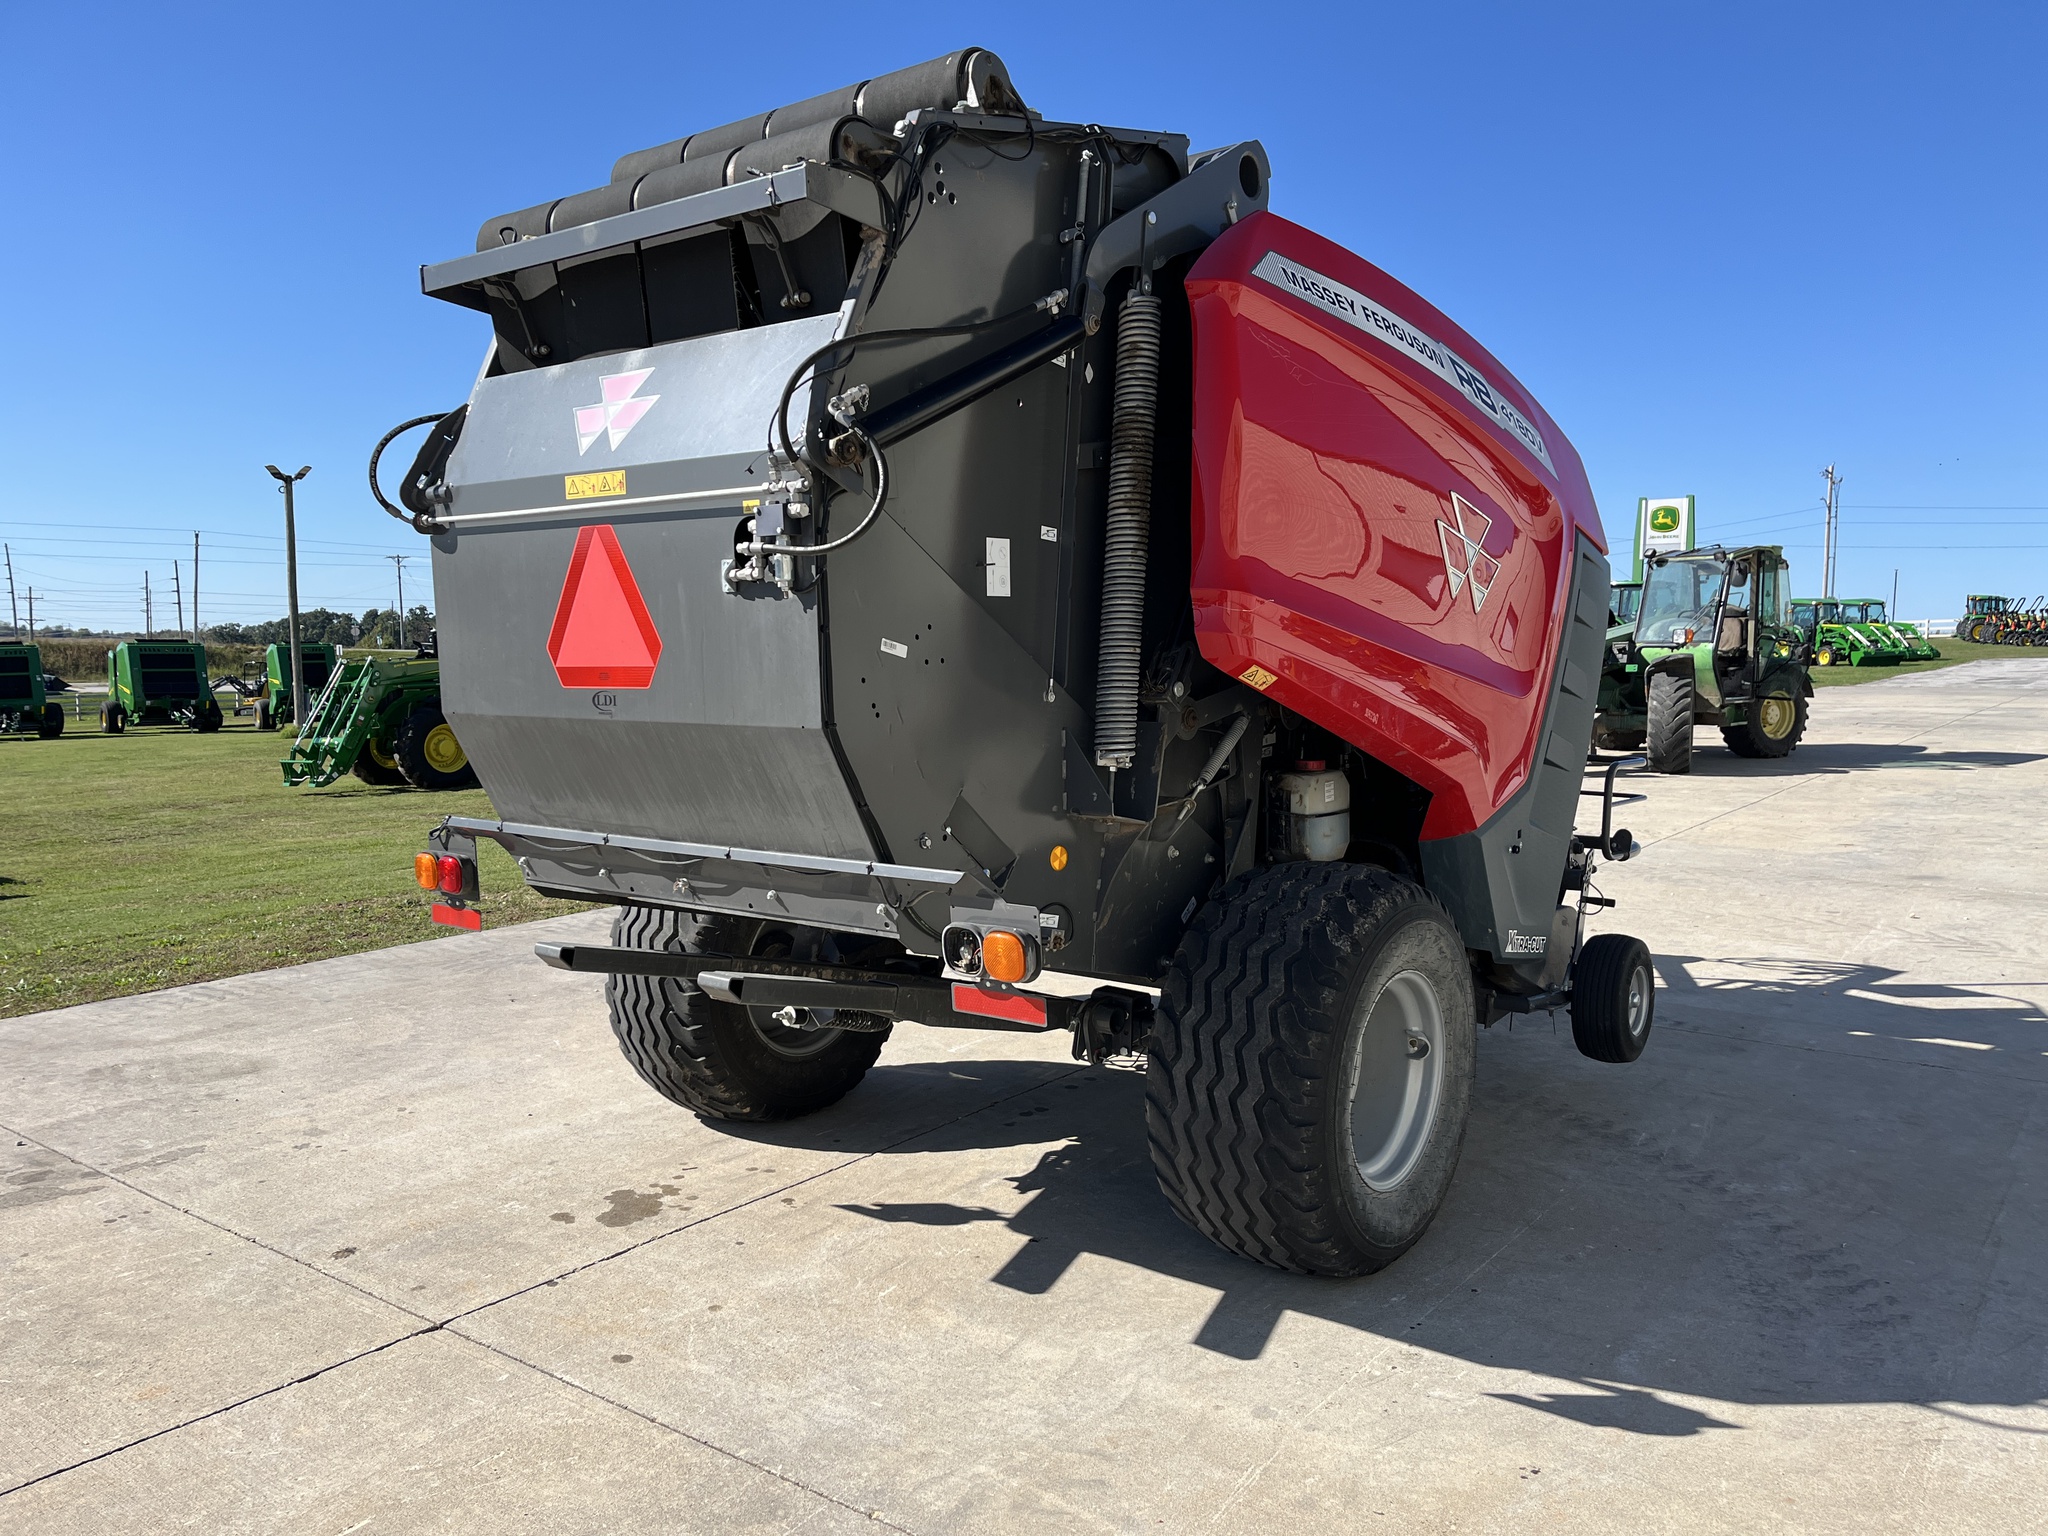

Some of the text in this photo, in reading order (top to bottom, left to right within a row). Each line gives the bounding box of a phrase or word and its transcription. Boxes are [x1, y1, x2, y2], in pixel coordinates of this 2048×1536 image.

[1280, 266, 1543, 454] MASSEY FERGUSON RB 4180V
